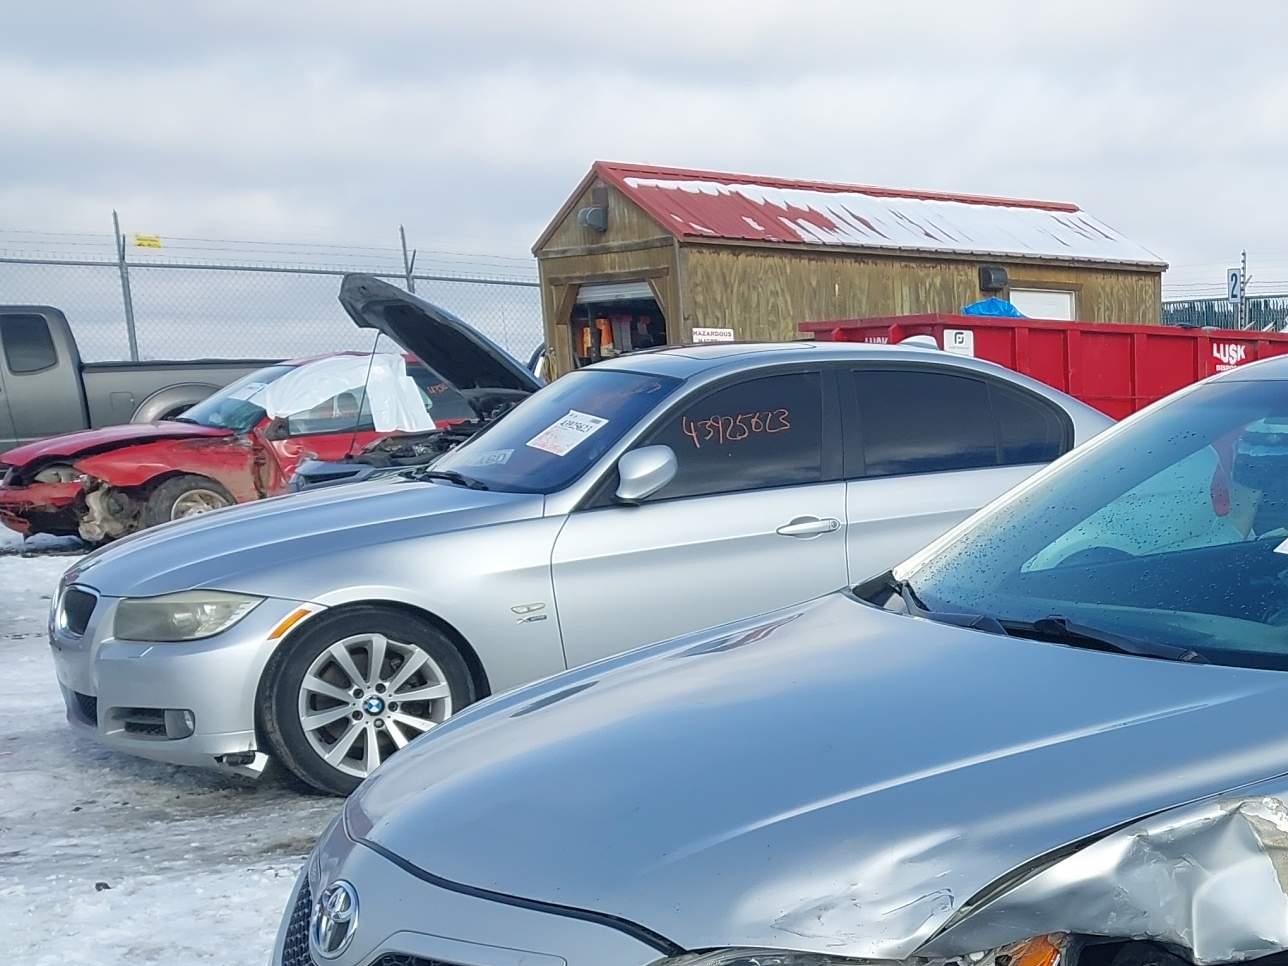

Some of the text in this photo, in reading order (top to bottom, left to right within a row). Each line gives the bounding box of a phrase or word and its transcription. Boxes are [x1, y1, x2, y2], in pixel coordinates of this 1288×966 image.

[1231, 272, 1239, 299] 2
[692, 330, 732, 338] HAZARDOUS
[1213, 343, 1246, 365] LUSK
